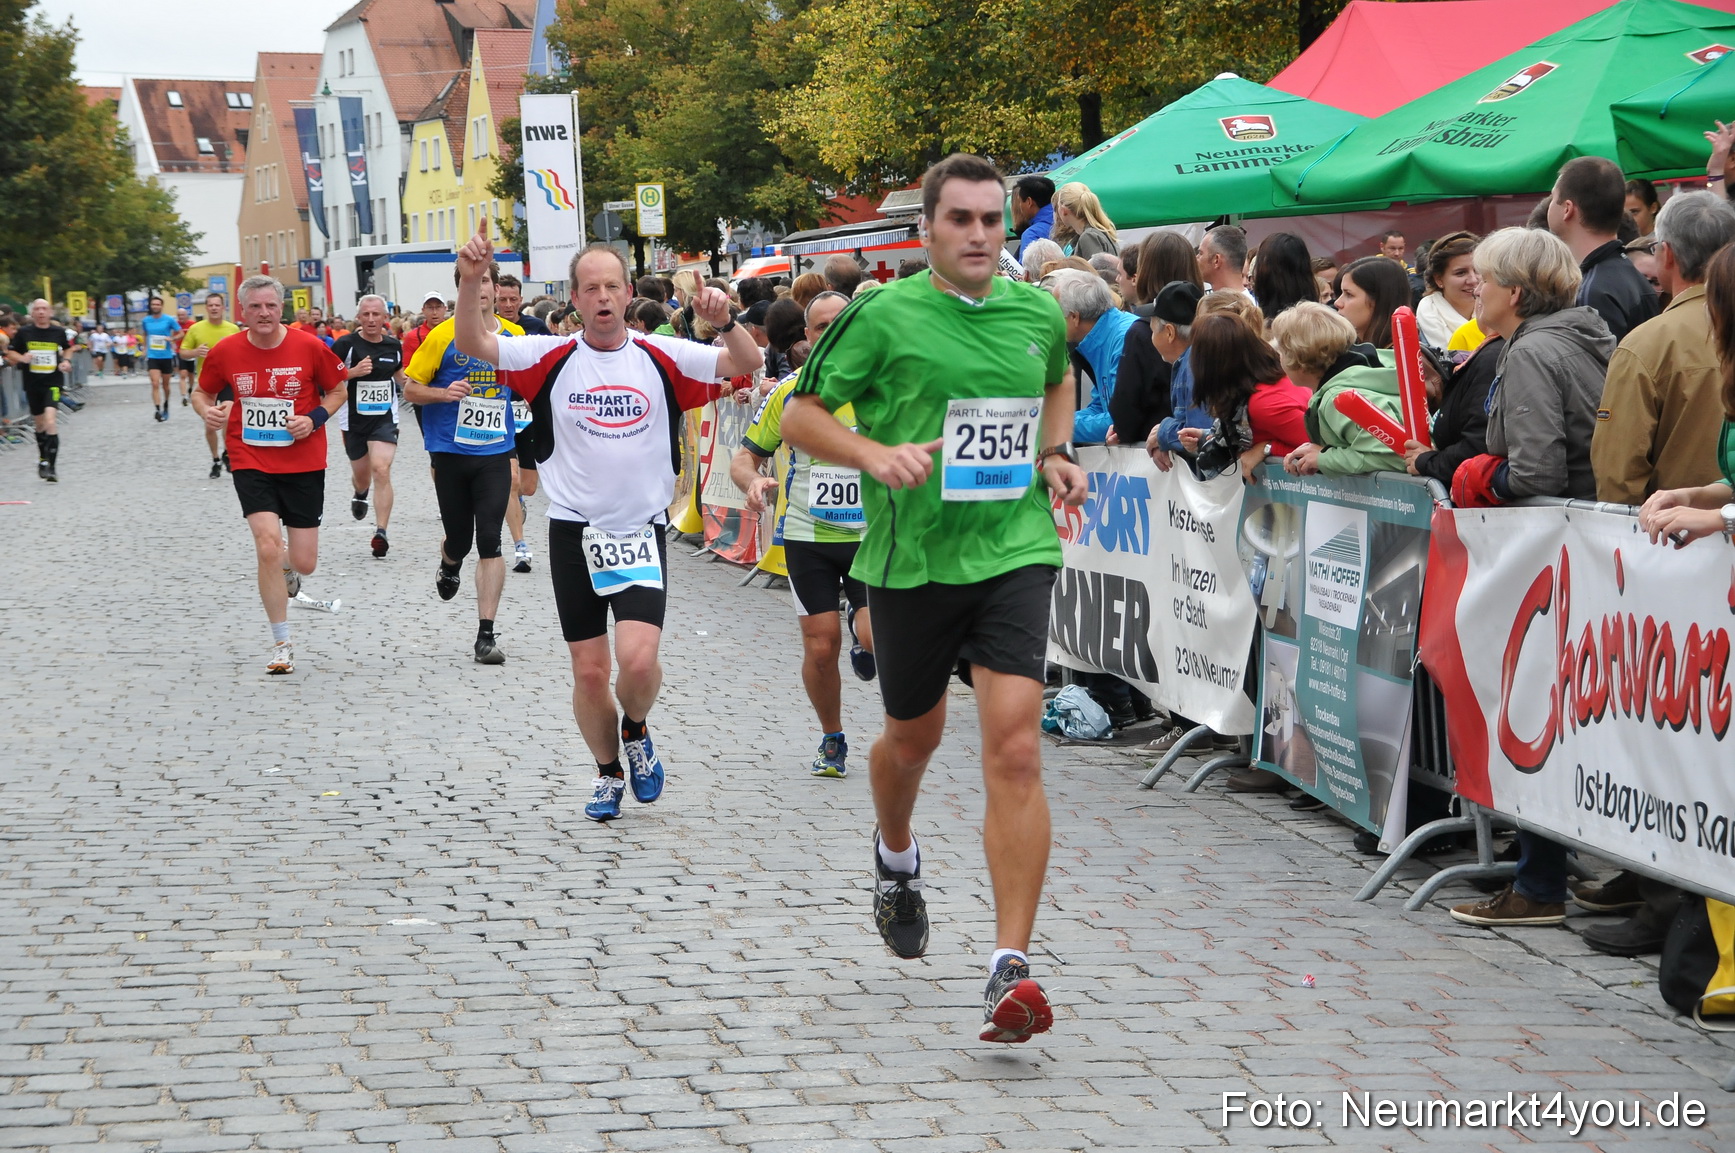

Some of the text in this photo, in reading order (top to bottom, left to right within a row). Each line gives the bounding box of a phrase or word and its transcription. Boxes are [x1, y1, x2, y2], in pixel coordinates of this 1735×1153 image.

[1195, 144, 1319, 161] Neumarkte
[1174, 154, 1291, 175] Lamms
[361, 389, 389, 402] 2458
[568, 392, 632, 406] GERHART
[246, 408, 288, 428] 2043
[463, 408, 502, 429] 2916
[595, 405, 642, 417] JÄNIG
[948, 408, 1027, 419] PARTL Neumarkt
[258, 431, 275, 440] Fritz
[469, 430, 494, 440] Florian
[575, 420, 650, 440] Das sportliche Autohaus
[955, 422, 1030, 461] 2554
[811, 472, 833, 480] PARTL
[975, 470, 1013, 486] Daniel
[815, 482, 859, 506] 290
[1398, 498, 1416, 515] Bayern
[825, 511, 863, 521] Manfred
[582, 531, 642, 541] PARTL Nearkt
[589, 541, 653, 569] 3354
[1330, 565, 1361, 588] HOFFER
[1497, 543, 1735, 776] Charivari
[1314, 704, 1340, 728] Trockenbau
[1574, 763, 1688, 844] Ostbayerns
